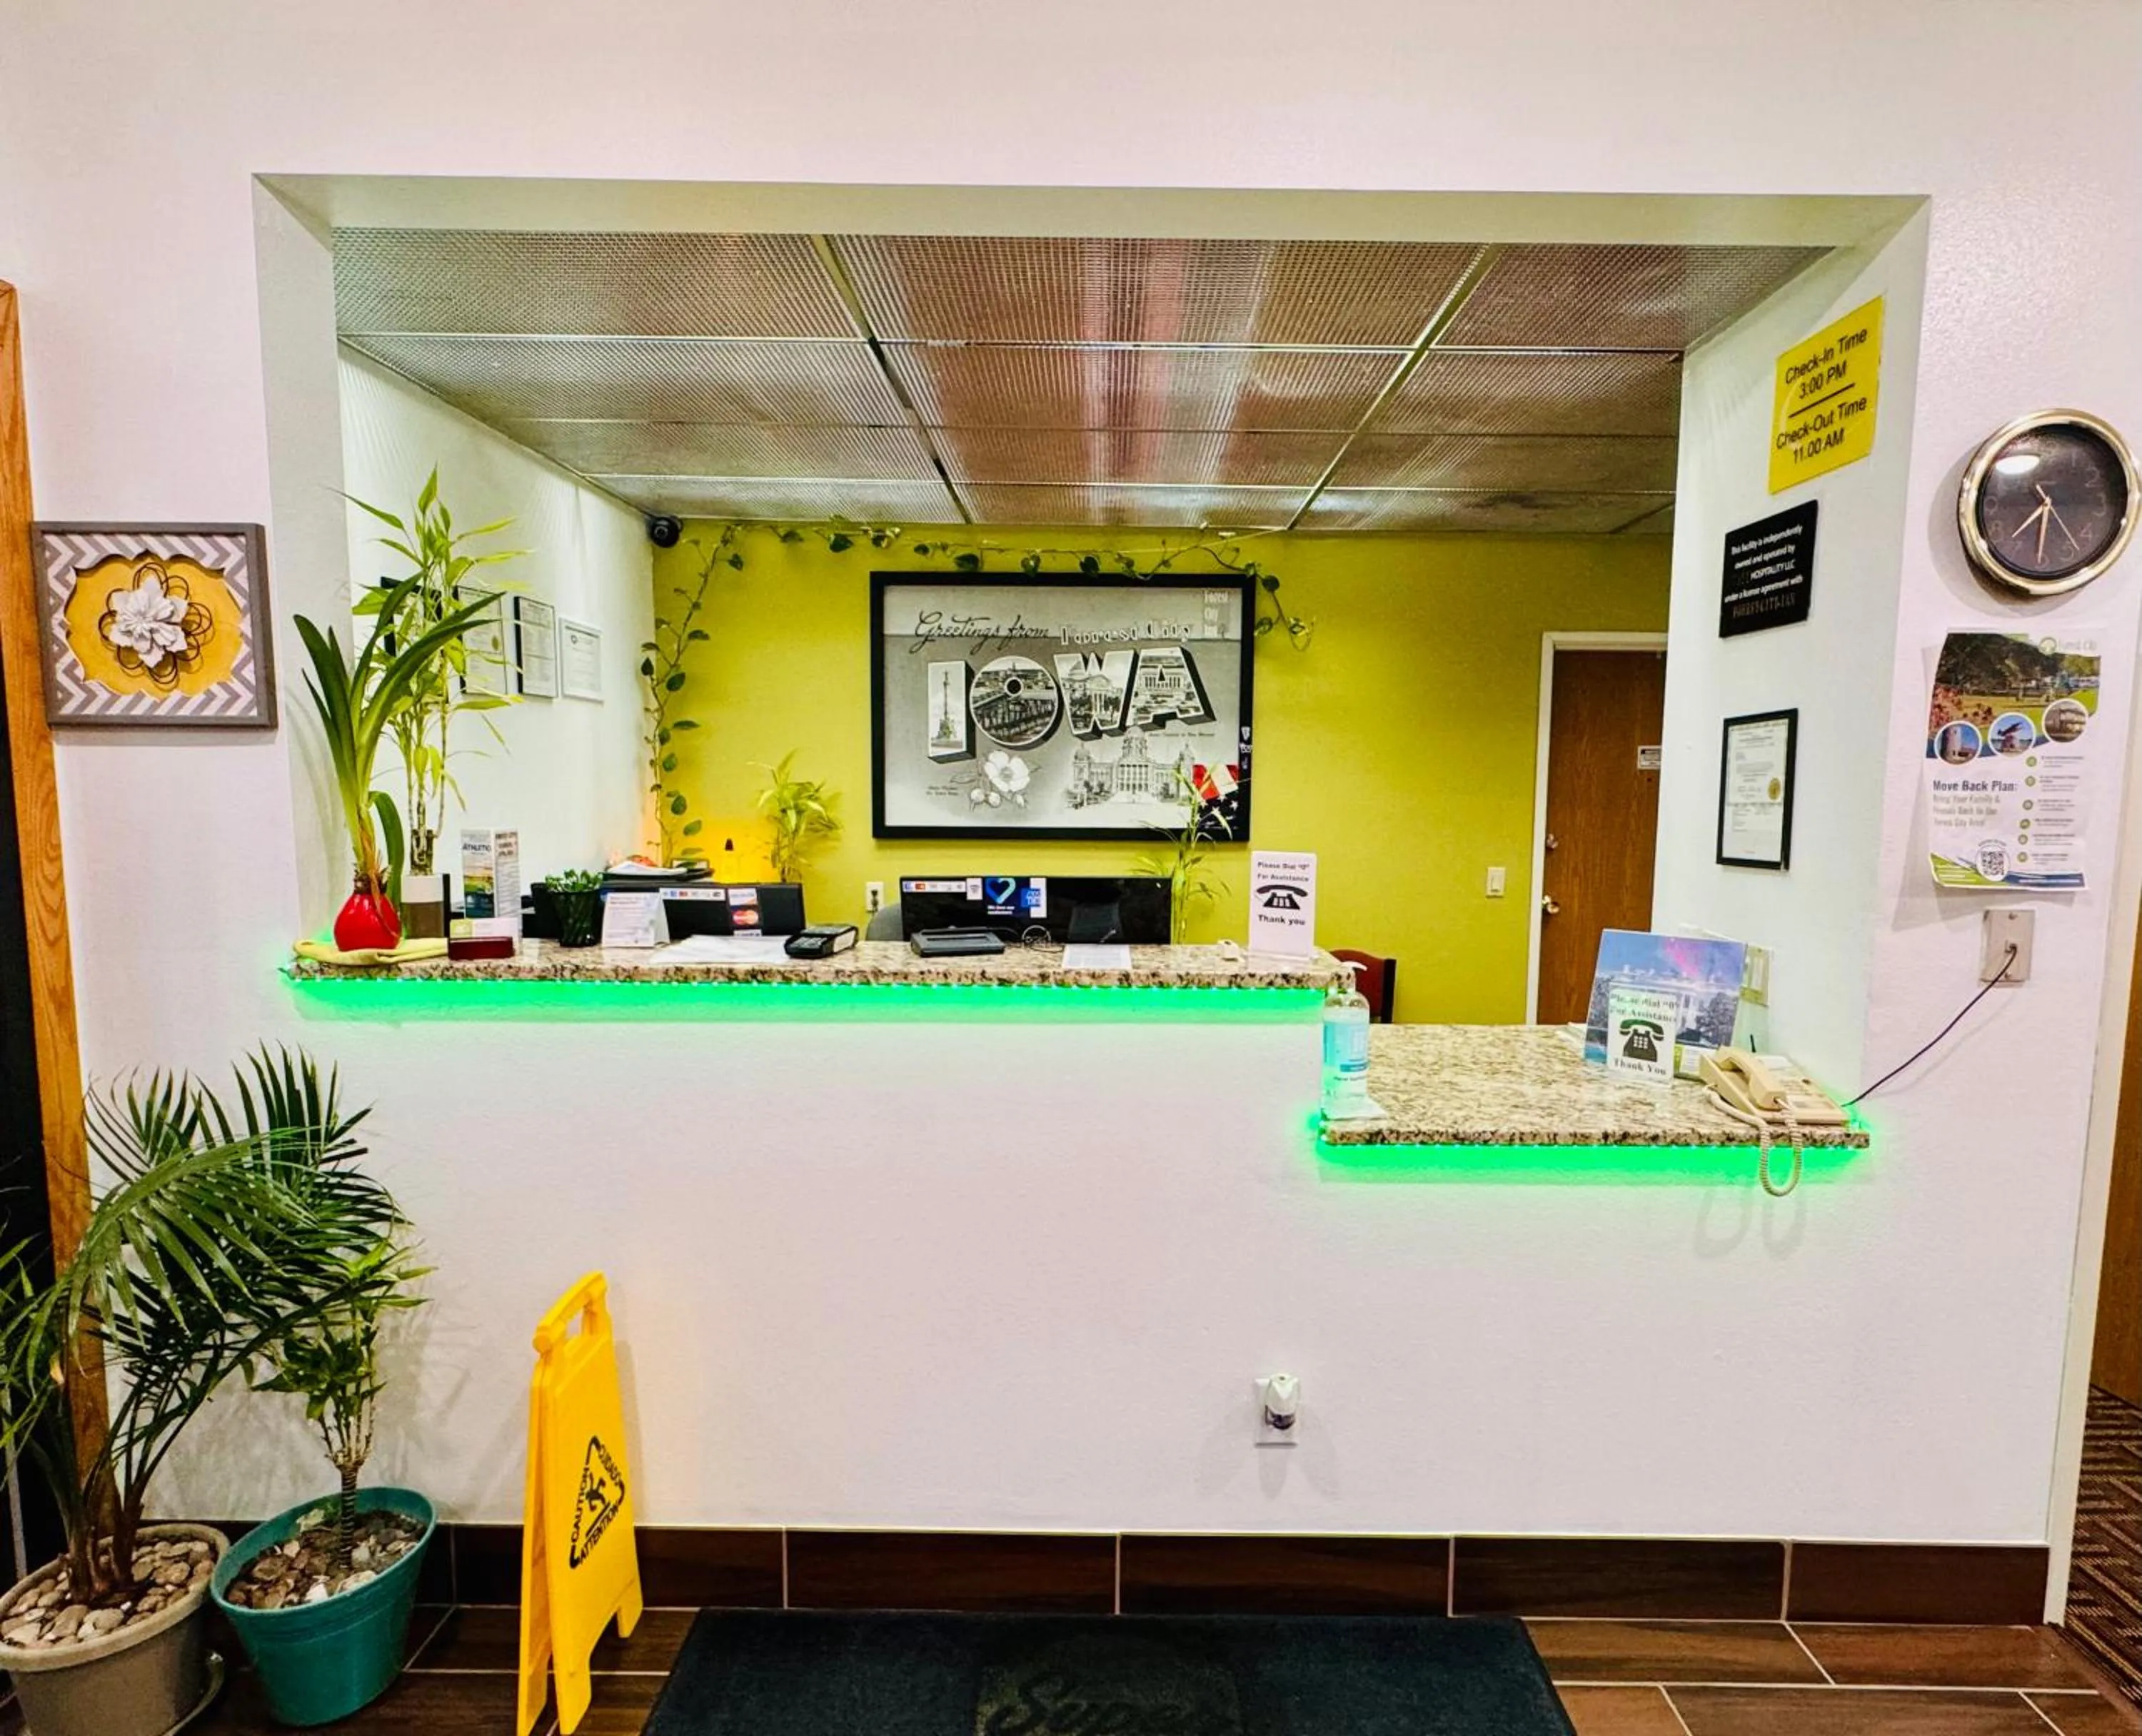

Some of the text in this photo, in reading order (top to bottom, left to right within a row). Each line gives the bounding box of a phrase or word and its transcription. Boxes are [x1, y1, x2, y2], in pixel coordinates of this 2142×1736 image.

[1786, 329, 1867, 384] Check-In Time
[1799, 360, 1846, 399] 3:00 PM
[1776, 397, 1867, 449] Check-Out Time
[1824, 427, 1844, 450] AM
[908, 610, 1000, 655] Greetings
[997, 614, 1049, 651] from
[927, 646, 1217, 764] IOWA
[1933, 780, 2018, 792] Move Back Plan:
[1258, 914, 1286, 924] Thank
[1614, 1058, 1666, 1075] Thank You
[571, 1465, 590, 1543] CAUTION
[580, 1503, 619, 1565] ATTENTION
